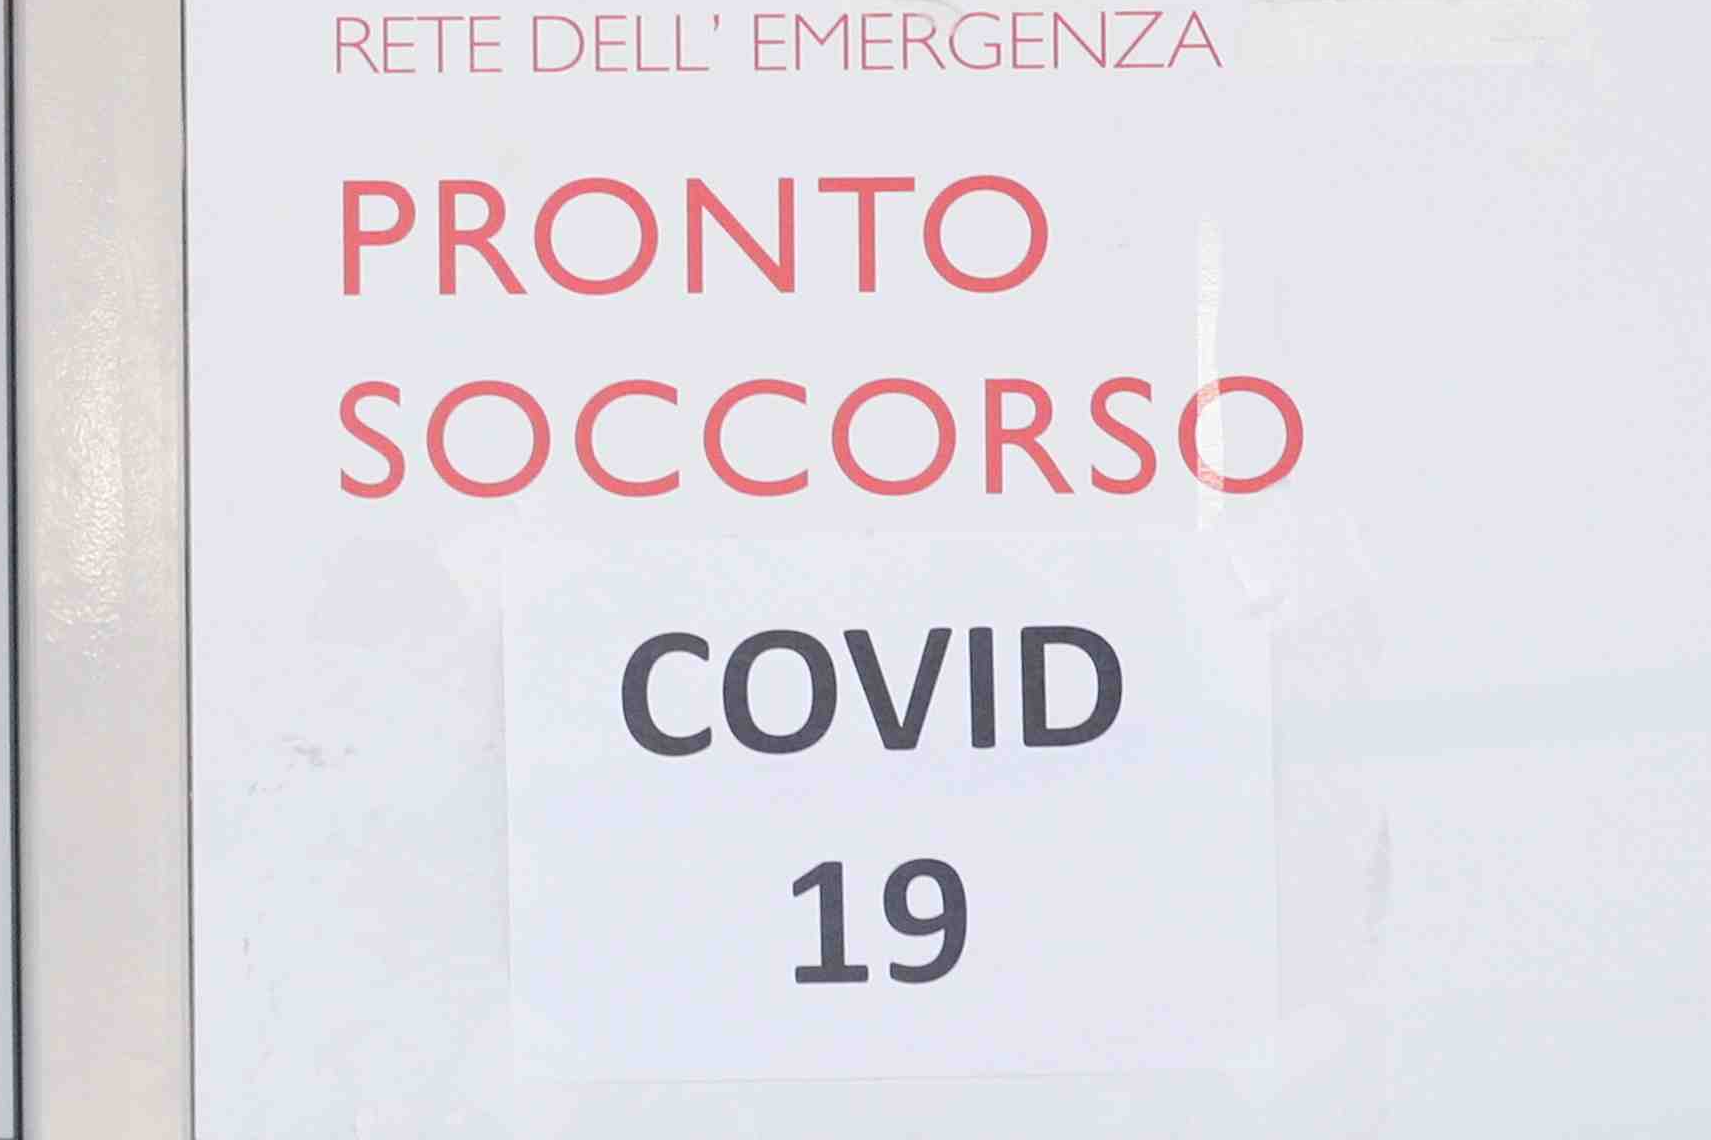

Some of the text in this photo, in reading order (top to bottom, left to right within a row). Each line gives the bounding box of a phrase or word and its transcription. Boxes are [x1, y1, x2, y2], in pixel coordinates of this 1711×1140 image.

[336, 16, 501, 73] RETE
[754, 11, 1222, 70] EMERGENZA
[343, 175, 1048, 295] PRONTO
[340, 376, 1303, 498] SOCCORSO
[622, 626, 1122, 756] COVID
[793, 858, 967, 984] 19
